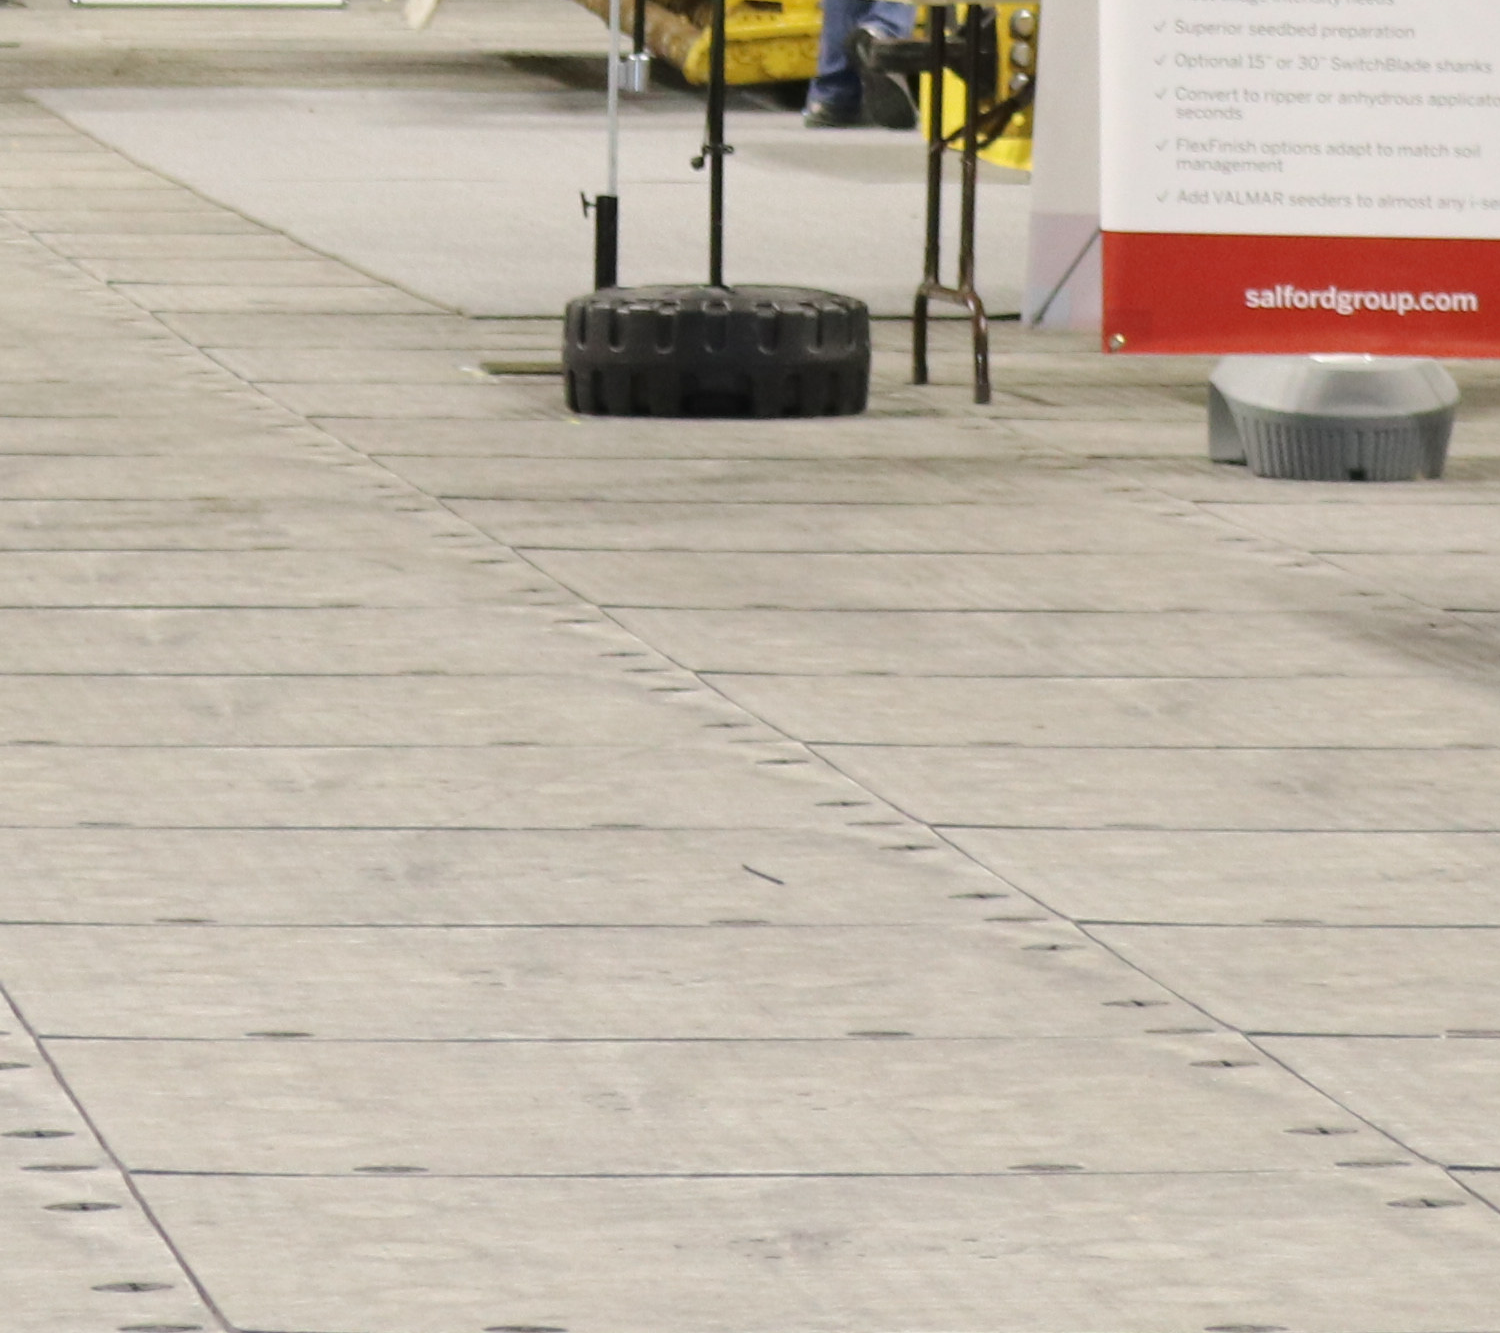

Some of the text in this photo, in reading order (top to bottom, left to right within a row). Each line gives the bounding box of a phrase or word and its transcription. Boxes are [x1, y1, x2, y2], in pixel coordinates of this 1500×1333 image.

[1174, 19, 1415, 41] Superior seedbed preparation
[1174, 53, 1243, 71] Optional
[1276, 57, 1293, 71] or
[1331, 56, 1431, 72] SwitchBlade
[1436, 58, 1493, 74] shanks
[1175, 86, 1240, 103] Convert
[1243, 88, 1260, 103] to
[1264, 89, 1312, 107] ripper
[1316, 92, 1334, 105] or
[1337, 91, 1423, 108] anhydrous
[1175, 107, 1243, 121] seconds
[1176, 138, 1482, 159] FlexFinish options adapt to match soil
[1176, 158, 1284, 174] management
[1177, 190, 1209, 206] Add
[1212, 191, 1284, 207] VALMAR
[1288, 192, 1351, 208] seeders
[1356, 194, 1373, 209] to
[1377, 195, 1433, 210] almost
[1437, 198, 1465, 213] any
[1244, 284, 1479, 316] salfordgroup.com
